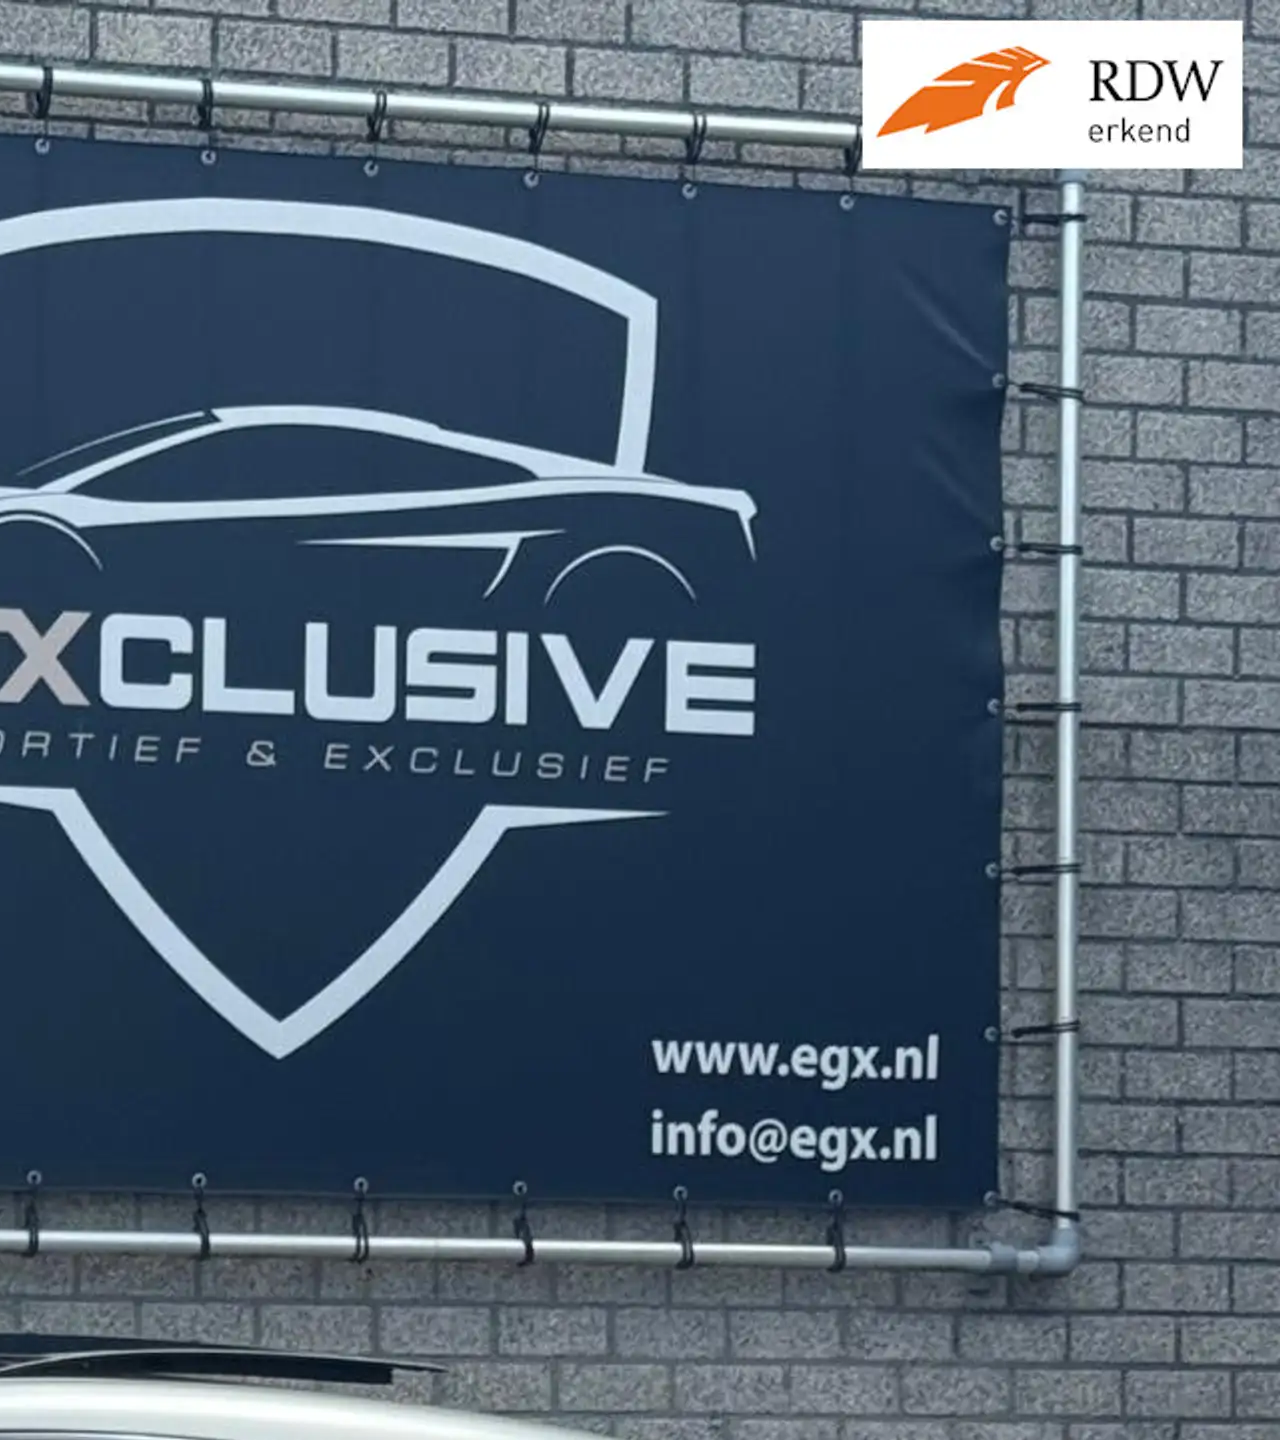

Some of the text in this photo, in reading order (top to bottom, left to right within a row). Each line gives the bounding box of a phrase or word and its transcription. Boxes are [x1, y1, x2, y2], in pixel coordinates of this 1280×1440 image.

[245, 740, 278, 767] &
[322, 742, 671, 784] EXCLUSIEF
[651, 1034, 939, 1091] www.egx.nl
[652, 1108, 937, 1172] info@egx.nl
